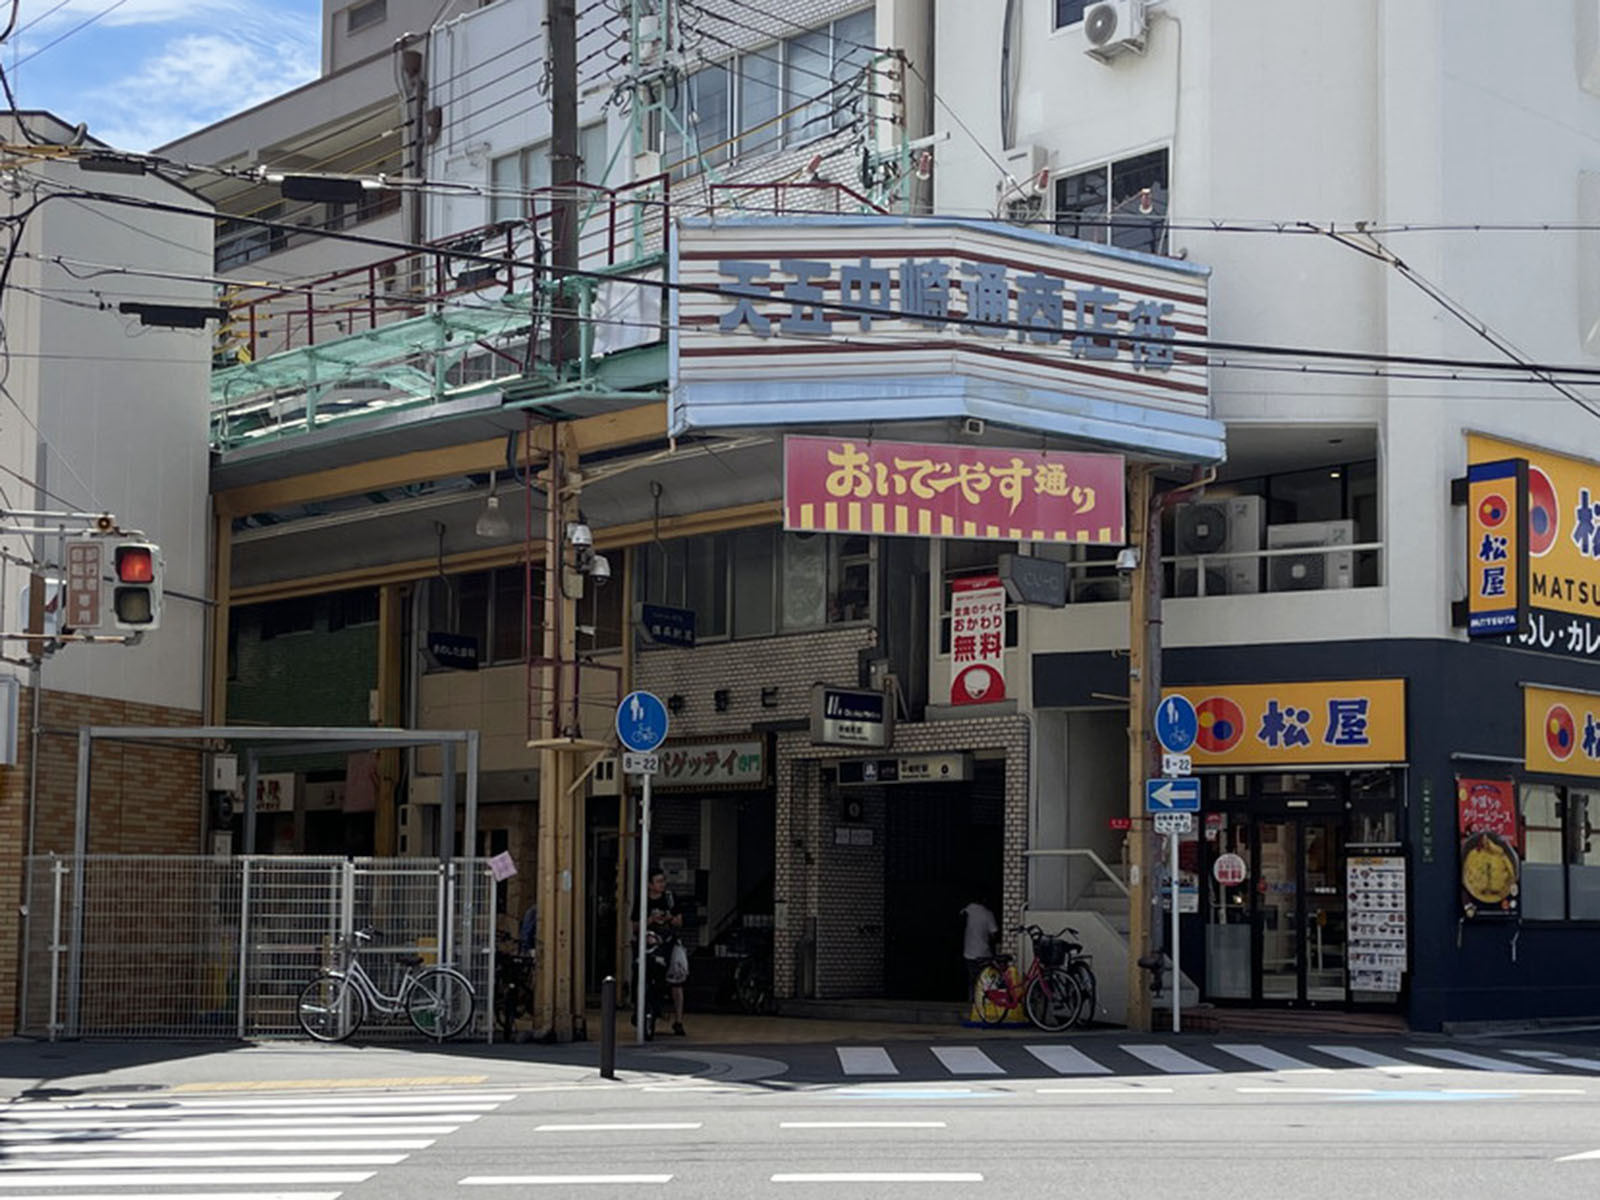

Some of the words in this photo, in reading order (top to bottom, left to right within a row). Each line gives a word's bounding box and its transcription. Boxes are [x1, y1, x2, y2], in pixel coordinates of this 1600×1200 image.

[718, 256, 1177, 372] 天五中崎通商店街
[826, 443, 1096, 516] おいでやす通り
[1478, 532, 1508, 597] 松屋
[954, 615, 1002, 632] おかわり
[954, 632, 1002, 663] 無料
[1256, 698, 1371, 748] 松屋
[625, 757, 657, 771] 8-22
